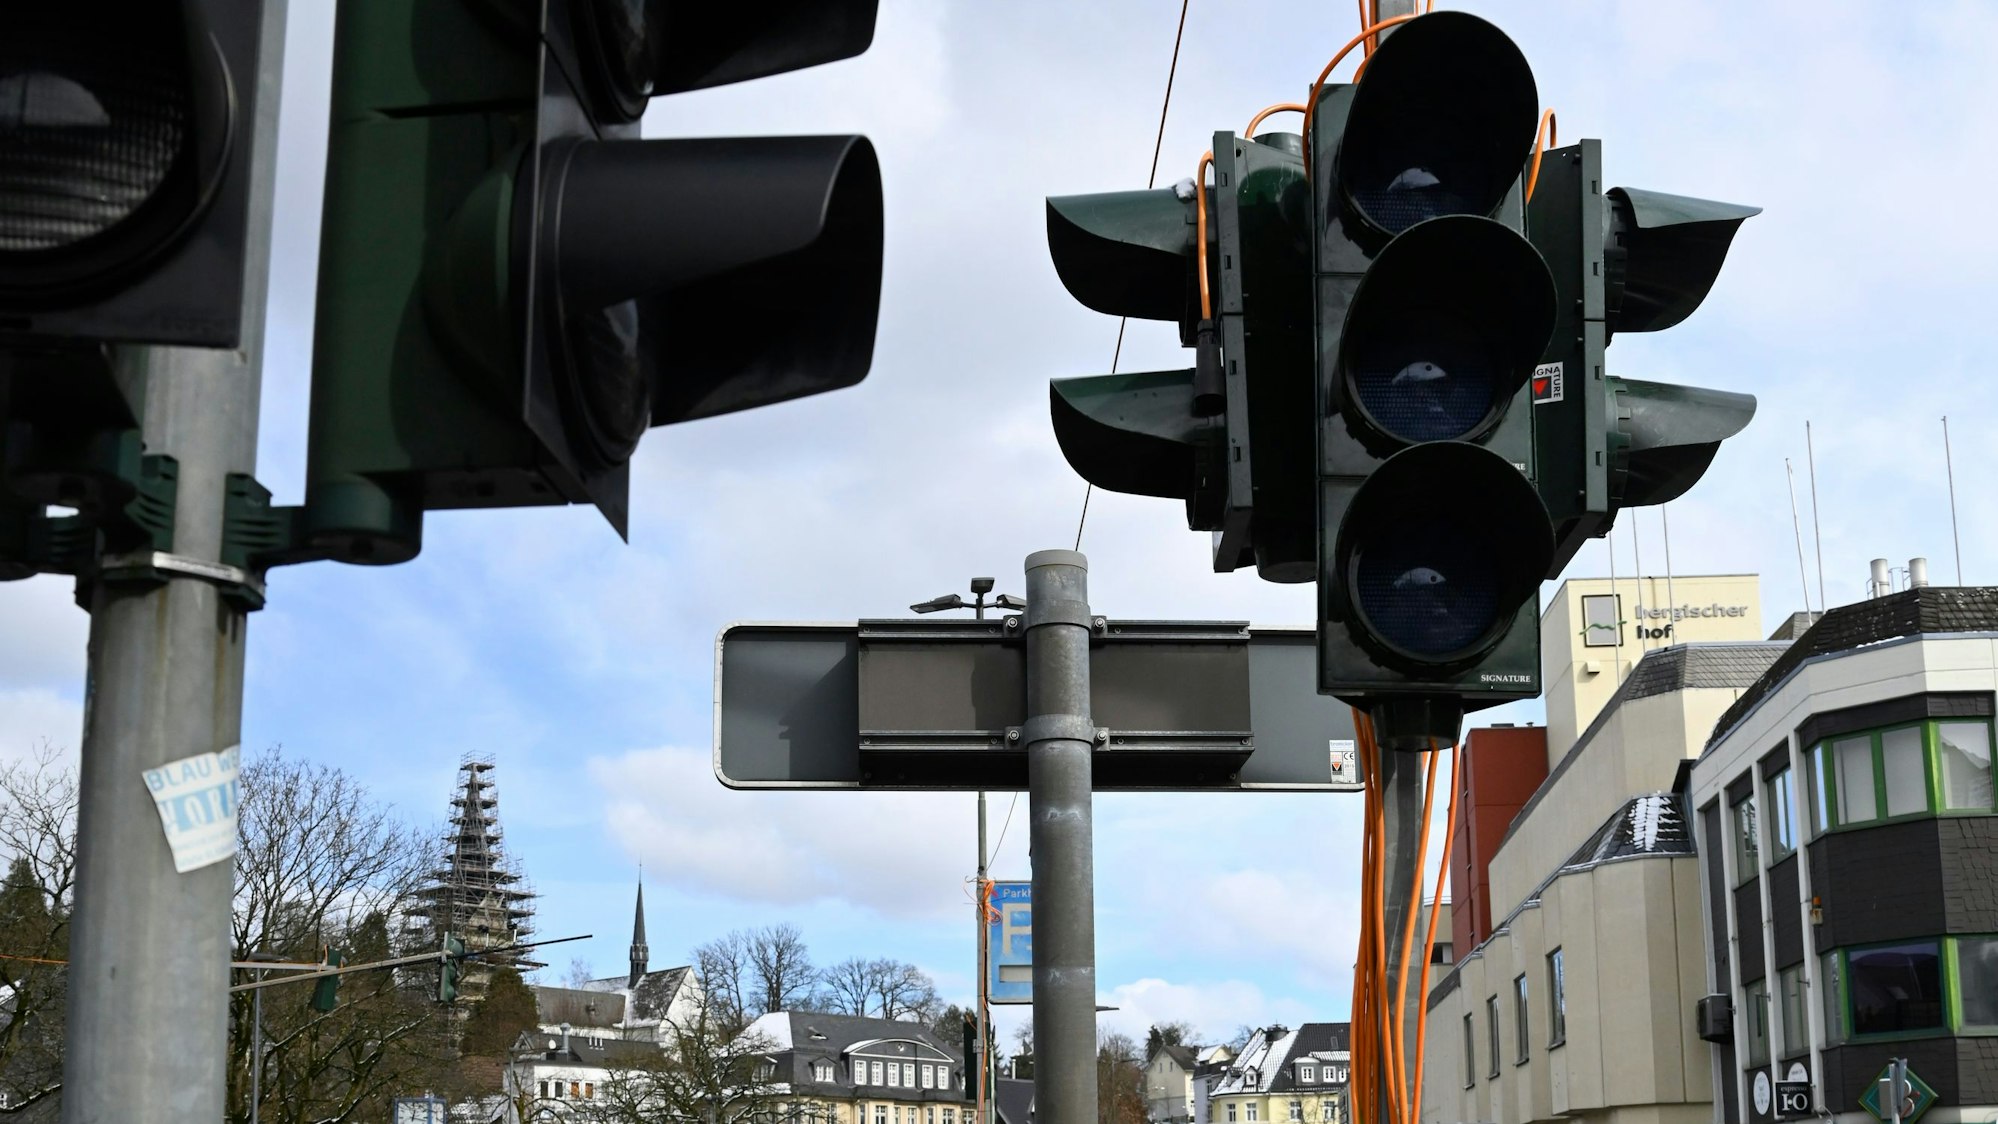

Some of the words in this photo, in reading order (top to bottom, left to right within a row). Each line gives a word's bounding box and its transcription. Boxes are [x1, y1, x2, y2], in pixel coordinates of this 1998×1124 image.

[1634, 603, 1748, 621] bergischer
[1637, 624, 1673, 639] hof
[1480, 674, 1531, 682] SIGNATURE
[147, 757, 211, 792] BLAU
